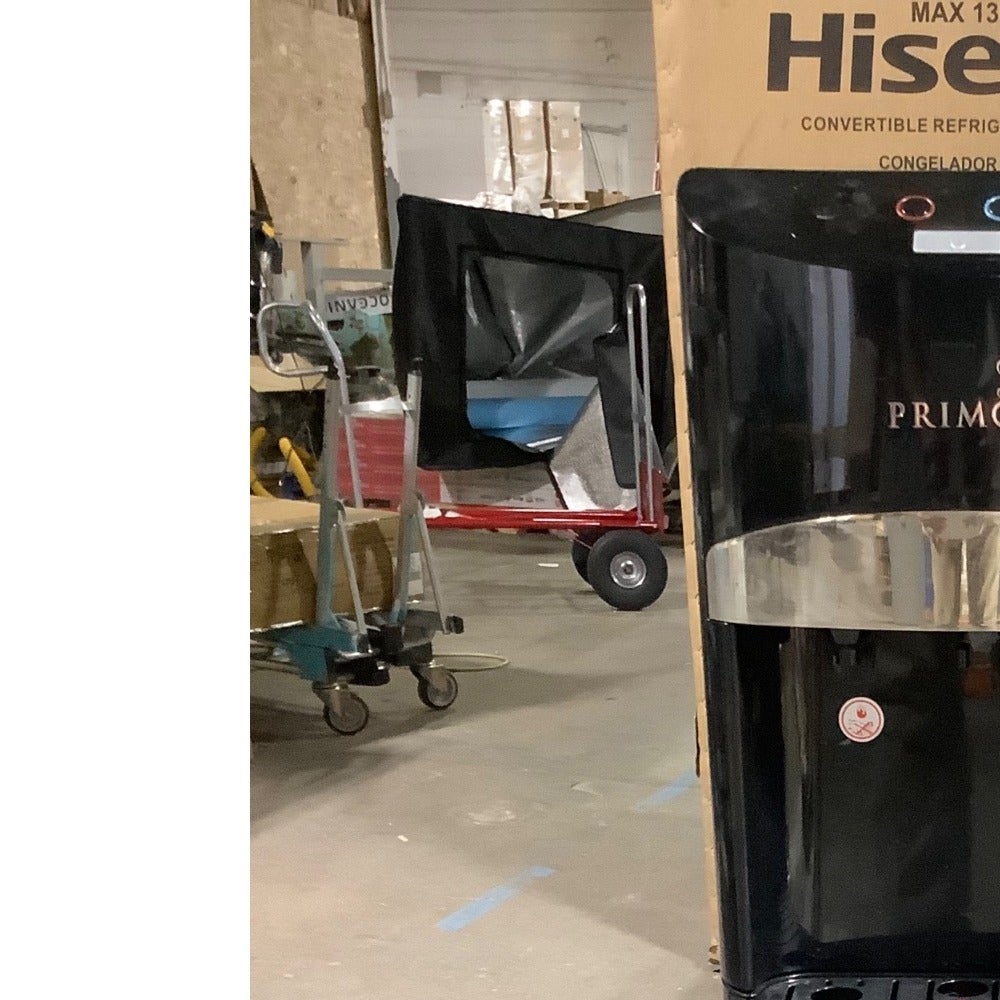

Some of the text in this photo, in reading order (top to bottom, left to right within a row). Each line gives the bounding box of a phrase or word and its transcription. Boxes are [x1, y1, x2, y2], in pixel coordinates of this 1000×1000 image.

[911, 1, 965, 23] MAX
[801, 116, 928, 133] CONVERTIBLE
[879, 155, 997, 170] CONGELADOR
